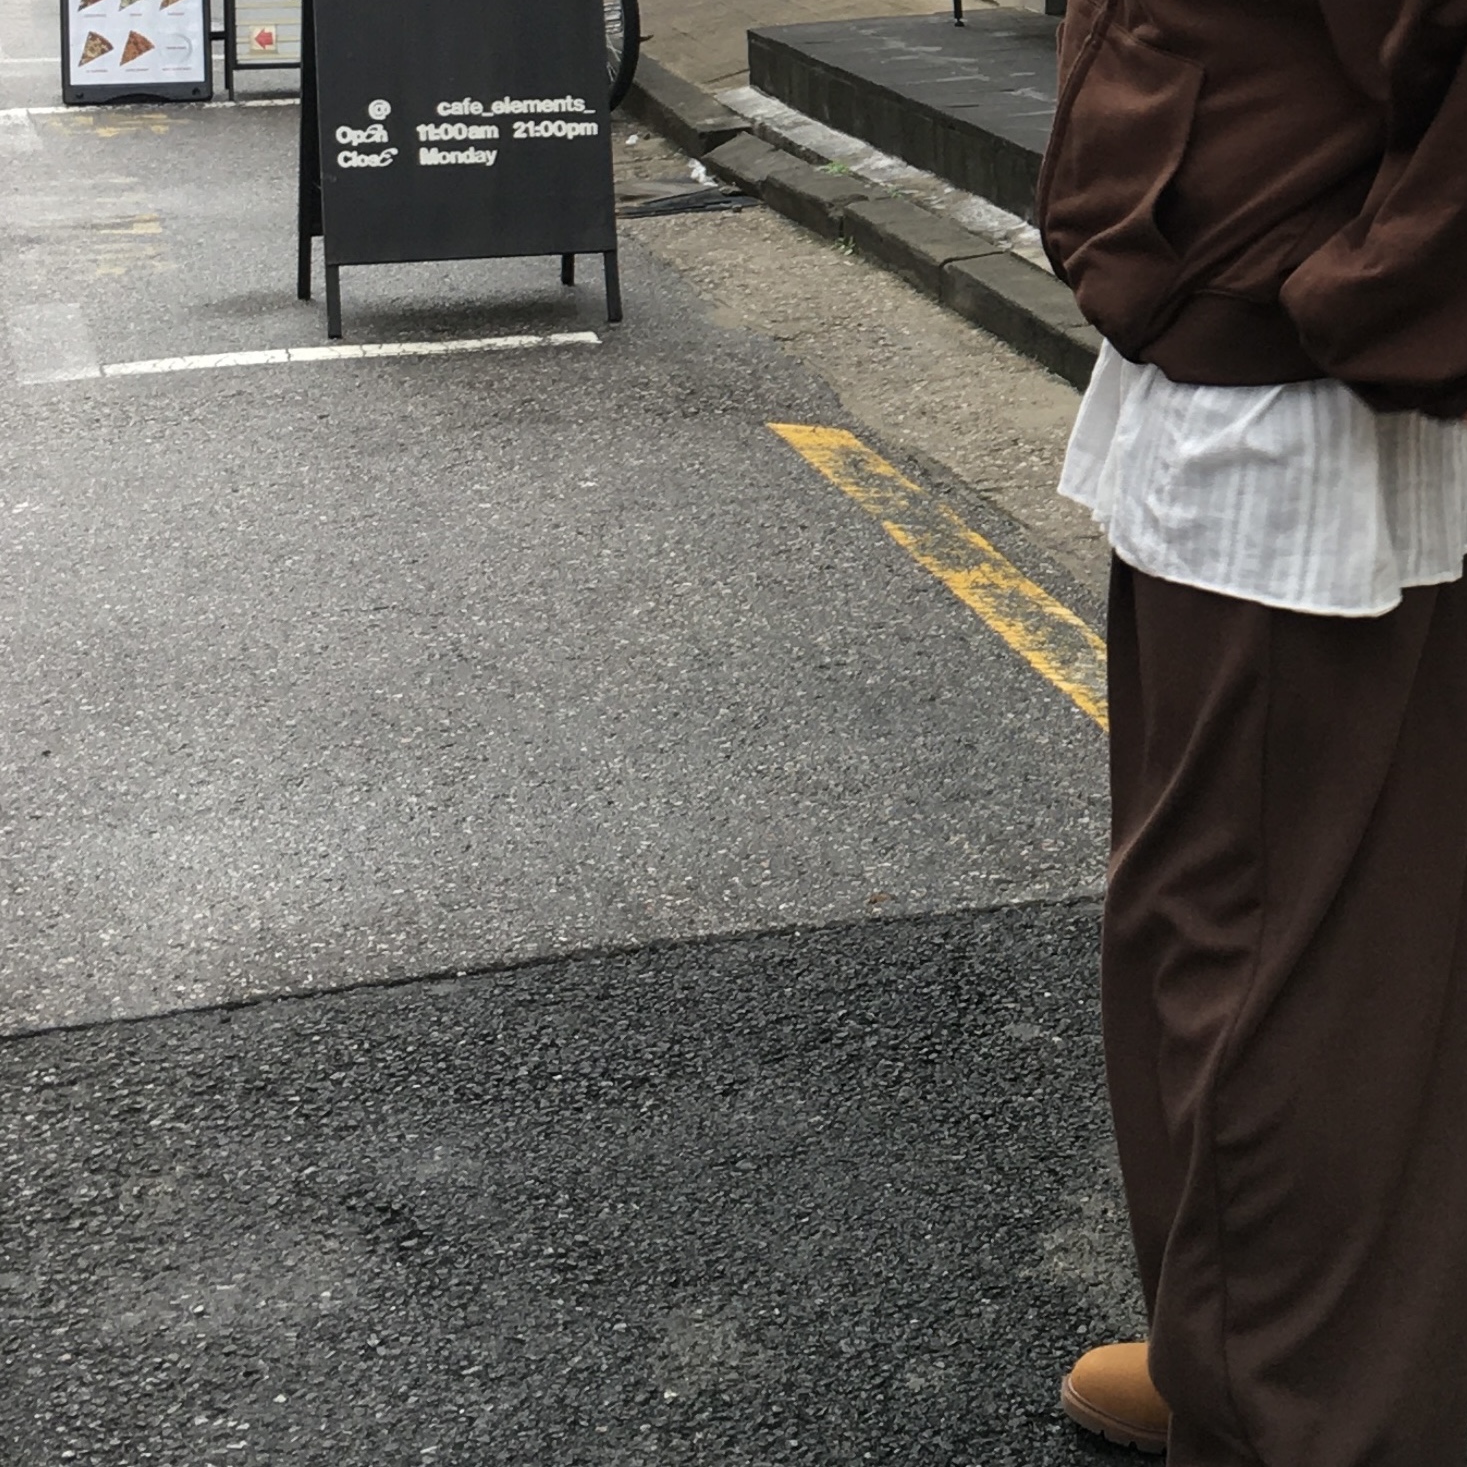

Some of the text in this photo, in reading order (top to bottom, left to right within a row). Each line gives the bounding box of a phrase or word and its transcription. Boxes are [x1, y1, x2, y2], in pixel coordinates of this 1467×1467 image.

[368, 95, 596, 120] @ cafe_elements_
[416, 123, 500, 142] 11:00am
[512, 120, 599, 140] 21:00pm
[418, 147, 498, 167] Monday
